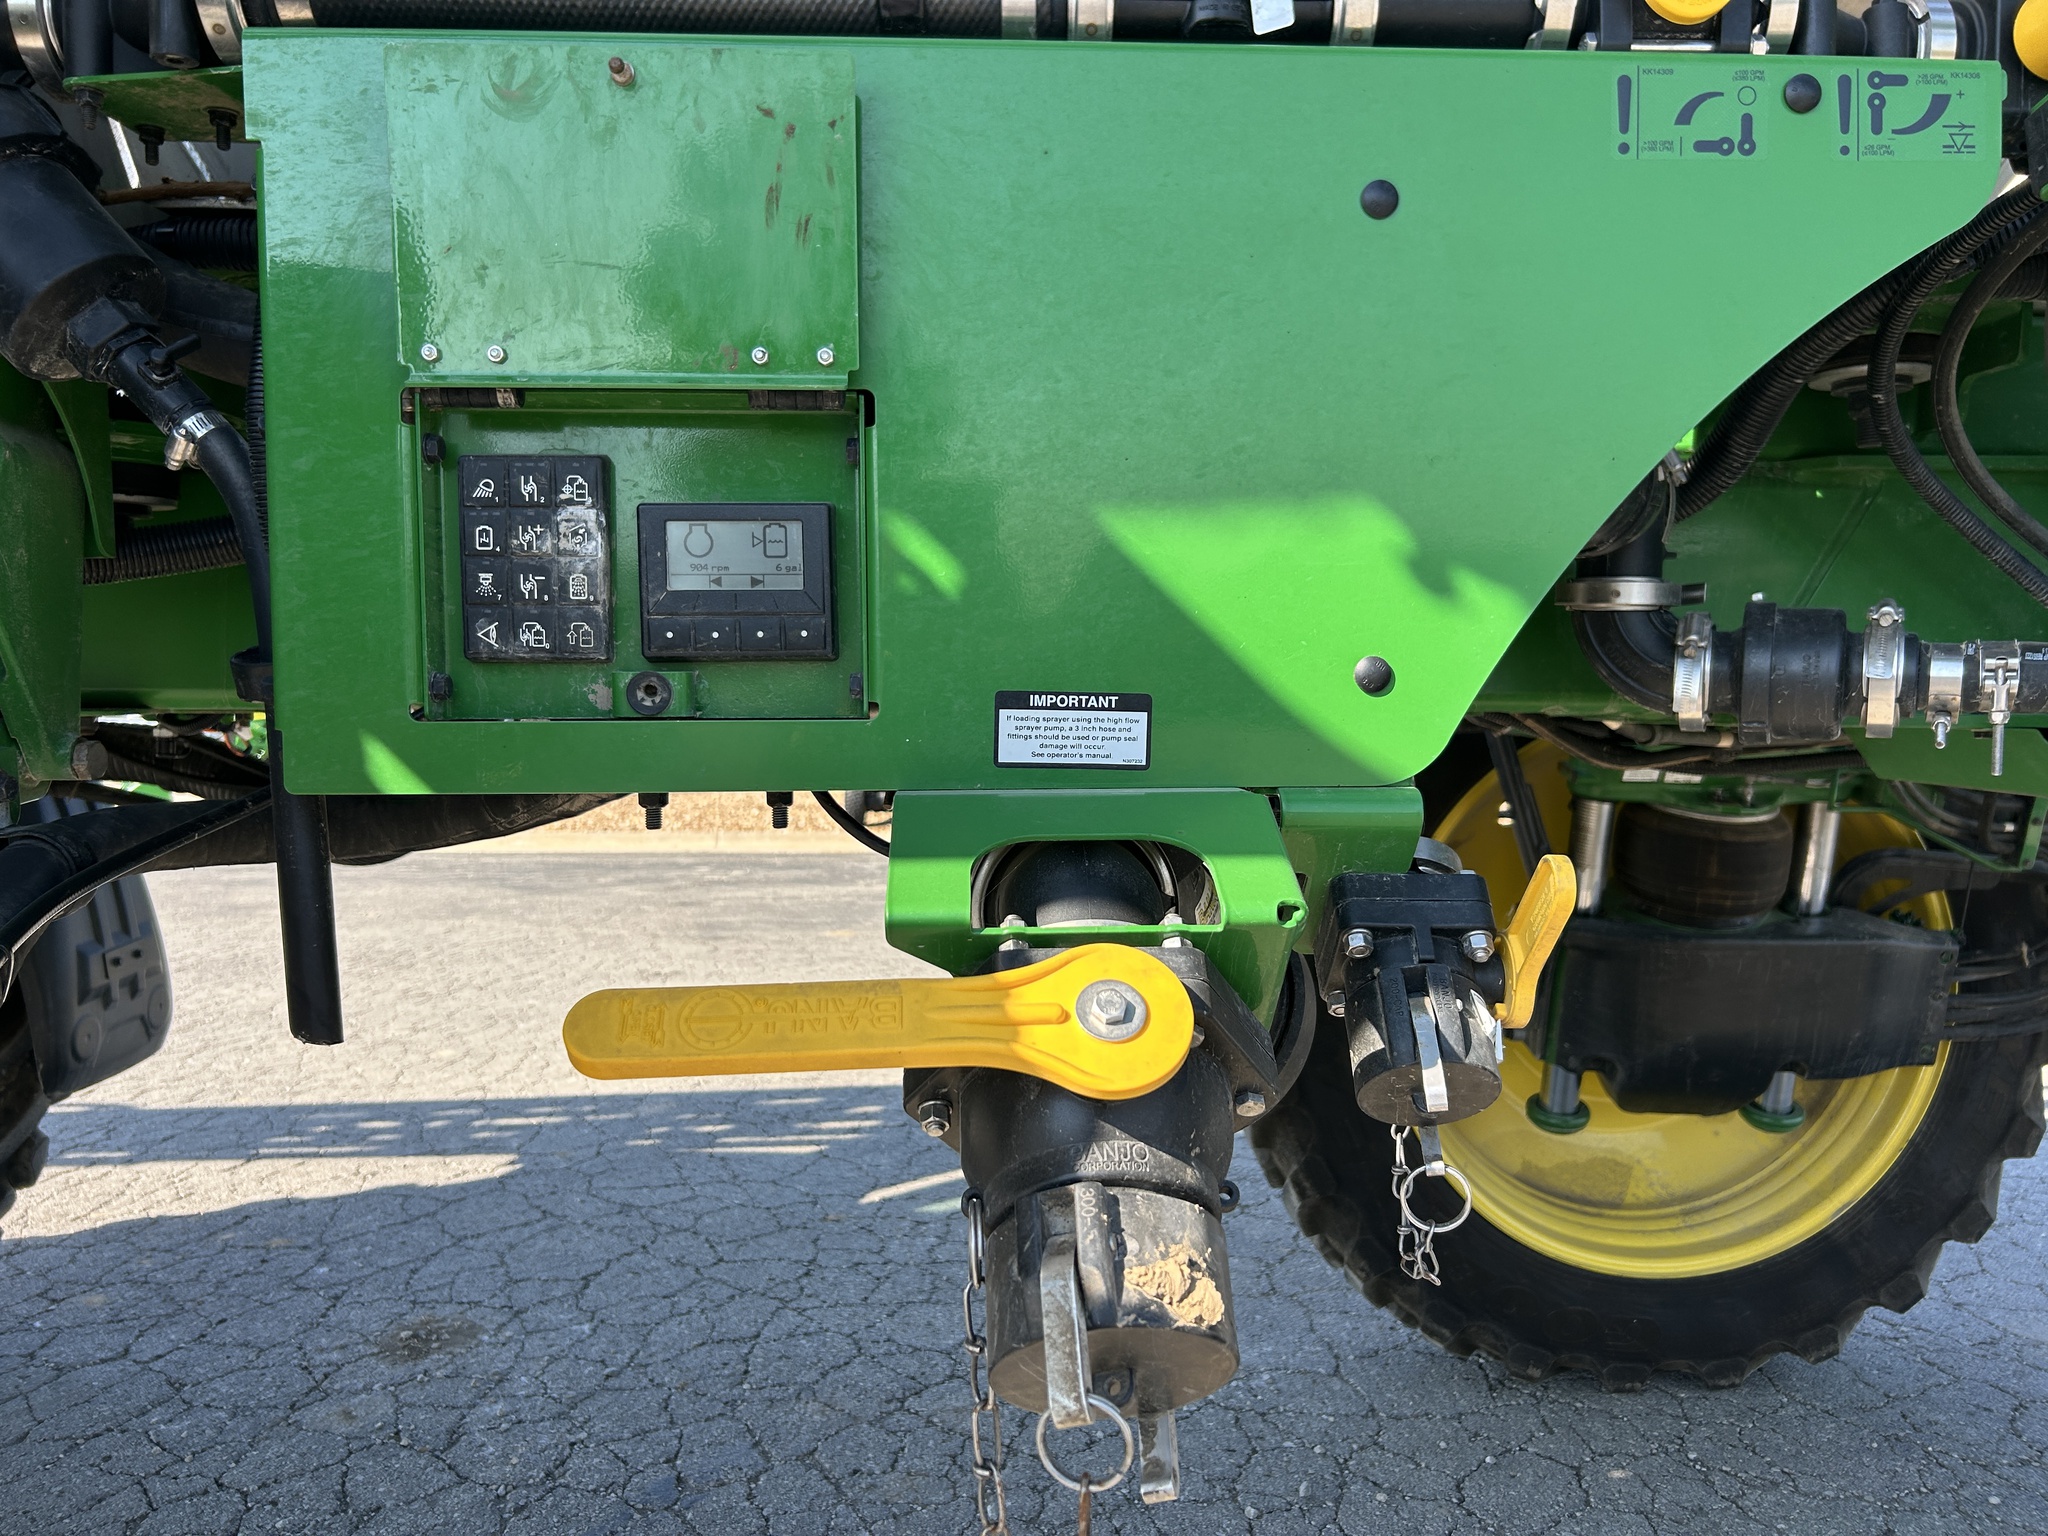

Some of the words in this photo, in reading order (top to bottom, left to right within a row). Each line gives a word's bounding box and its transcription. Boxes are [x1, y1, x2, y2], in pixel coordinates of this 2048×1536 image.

[1750, 75, 1765, 83] LPM)
[690, 563, 709, 572] 904
[711, 565, 730, 573] rpm
[775, 563, 783, 572] 6
[785, 563, 802, 573] gal
[1029, 694, 1119, 708] IMPORTANT
[1013, 715, 1040, 723] loading
[1042, 716, 1070, 724] sprayer
[1071, 717, 1092, 725] using
[1107, 716, 1123, 725] high
[1014, 724, 1041, 732] sprayer
[1043, 725, 1067, 733] pump,
[1007, 733, 1033, 741] fittings
[1034, 733, 1059, 741] should
[1061, 733, 1071, 741] be
[1101, 735, 1122, 743] pump
[1039, 742, 1068, 750] damage
[1046, 752, 1084, 760] operator's
[1439, 977, 1454, 1010] BANJO
[1073, 1160, 1150, 1172] CORPORATION
